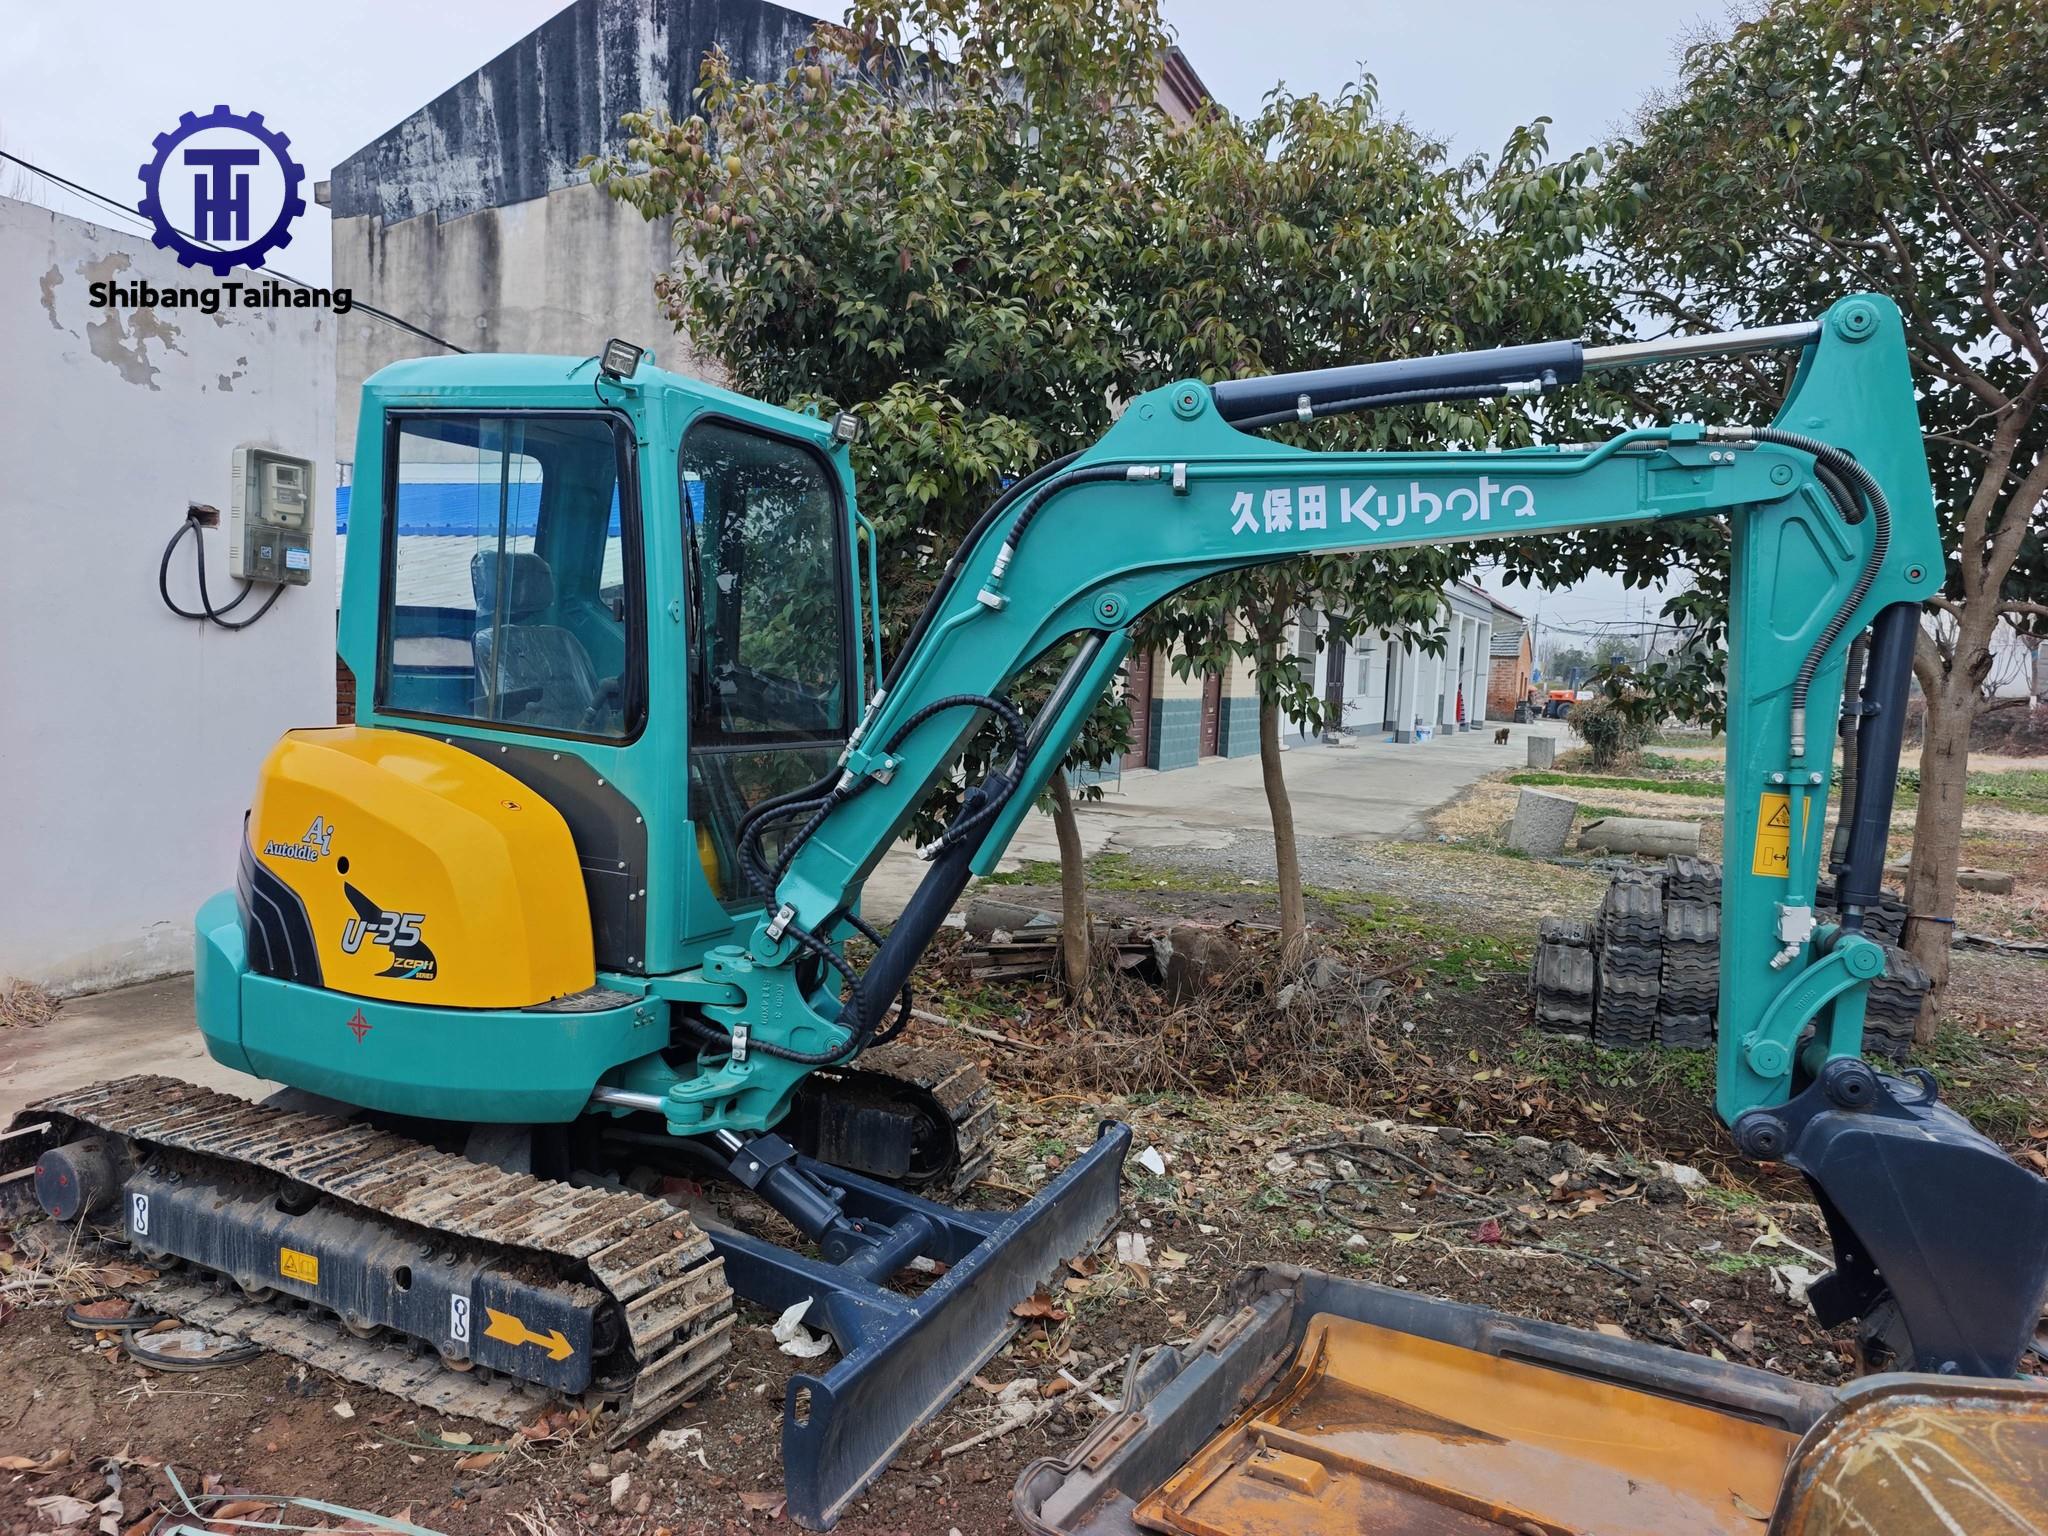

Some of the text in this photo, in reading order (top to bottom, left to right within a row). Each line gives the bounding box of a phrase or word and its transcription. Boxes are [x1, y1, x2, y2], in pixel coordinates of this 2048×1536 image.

[1230, 476, 1536, 535] 久保田 Kubota
[341, 911, 426, 954] U-35
